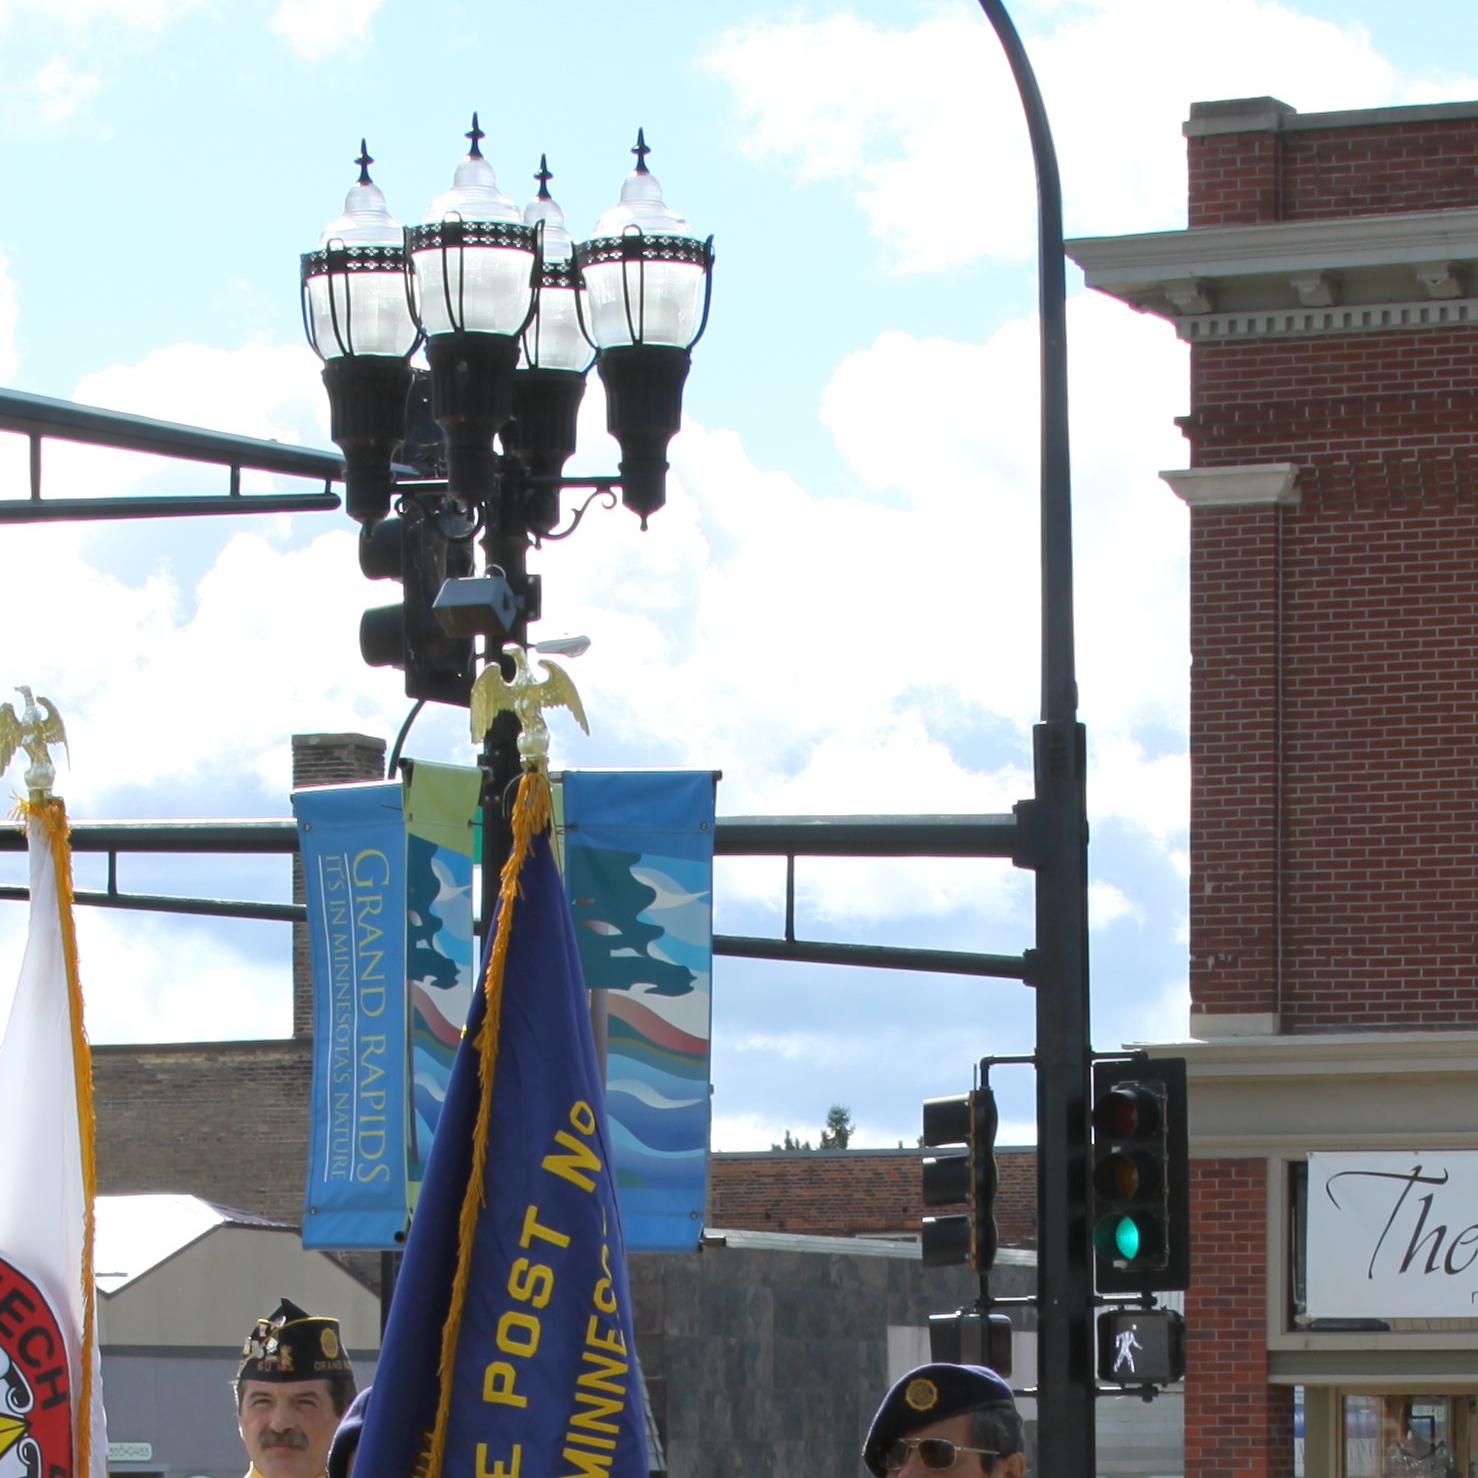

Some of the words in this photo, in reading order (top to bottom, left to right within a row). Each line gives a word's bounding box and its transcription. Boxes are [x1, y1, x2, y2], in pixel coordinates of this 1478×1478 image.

[326, 855, 345, 890] IT'S
[329, 900, 348, 925] IN
[353, 848, 390, 1017] GRAND
[332, 934, 351, 1083] MINNESOTA'S
[330, 1092, 349, 1180] NATURE
[357, 1034, 390, 1182] RAPIDS
[482, 1204, 571, 1408] POST
